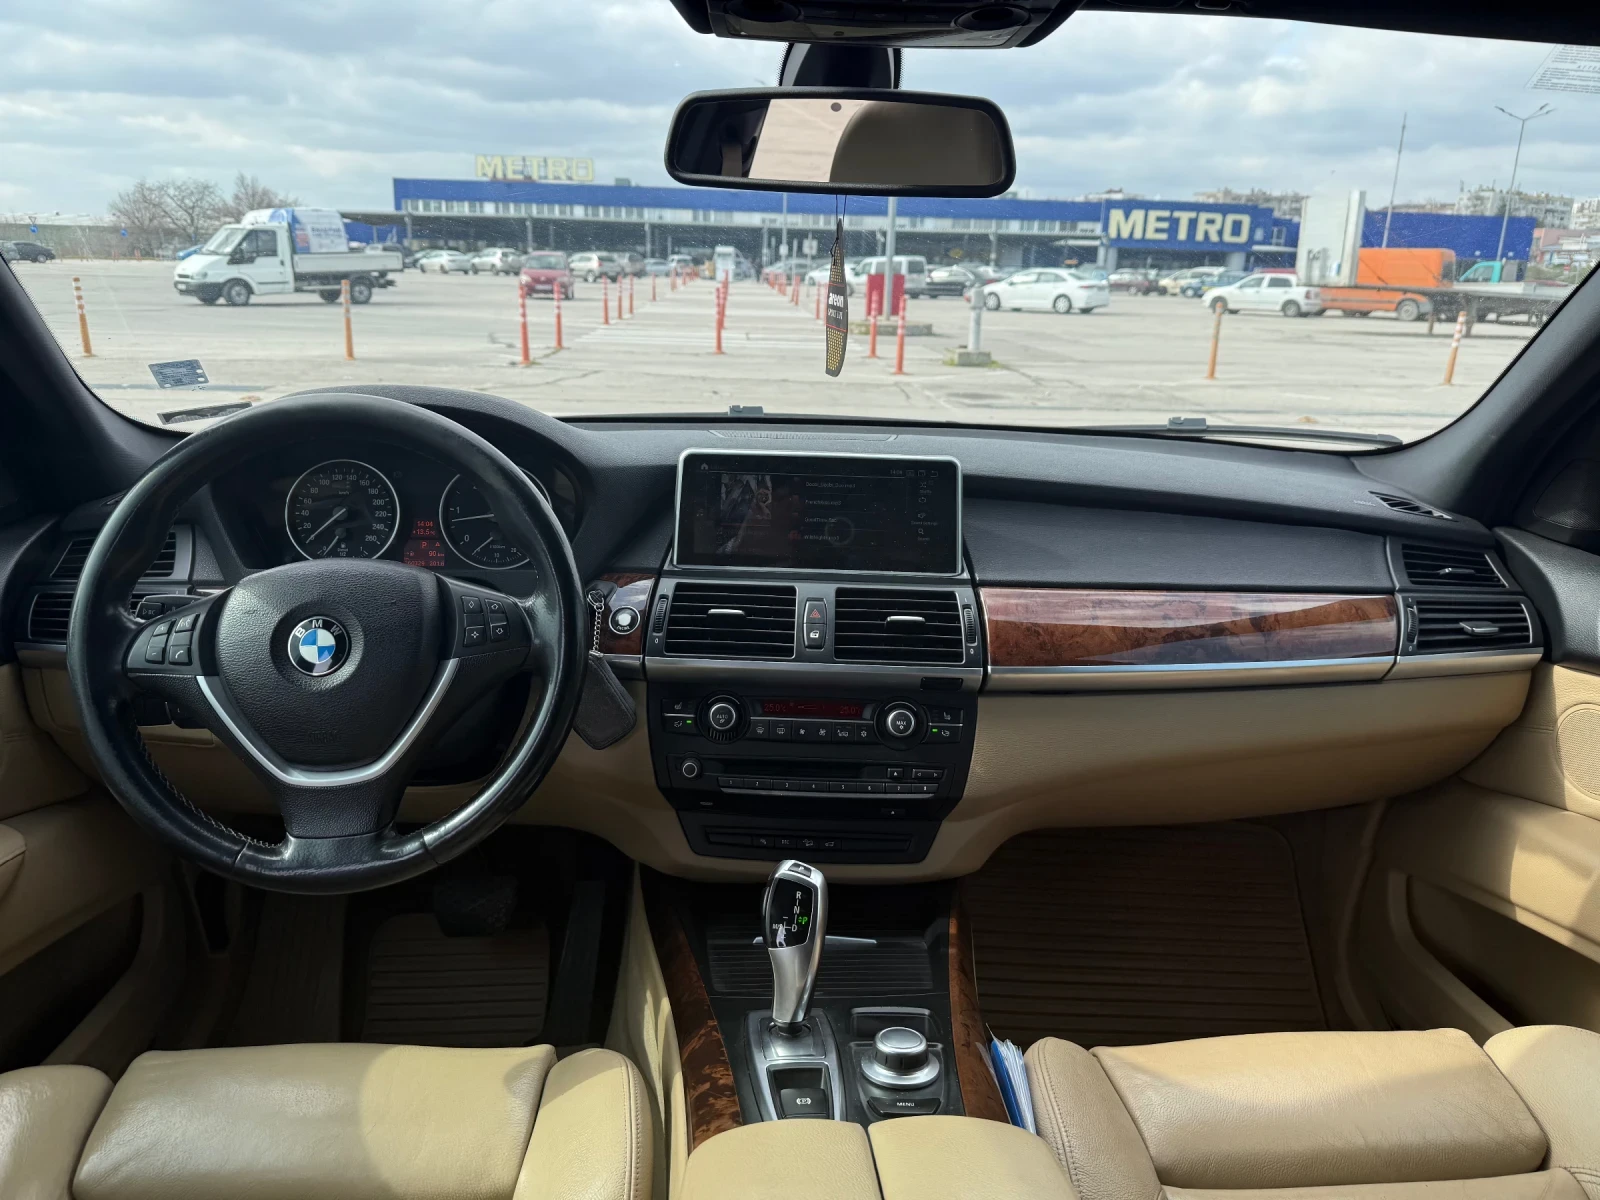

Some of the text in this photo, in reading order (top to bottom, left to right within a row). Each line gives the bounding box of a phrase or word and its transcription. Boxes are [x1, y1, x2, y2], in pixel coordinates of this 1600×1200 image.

[476, 155, 594, 181] METRO
[1108, 208, 1251, 244] METRO
[828, 292, 844, 308] areon
[295, 619, 342, 638] BMW
[796, 891, 801, 899] R
[794, 906, 800, 914] N
